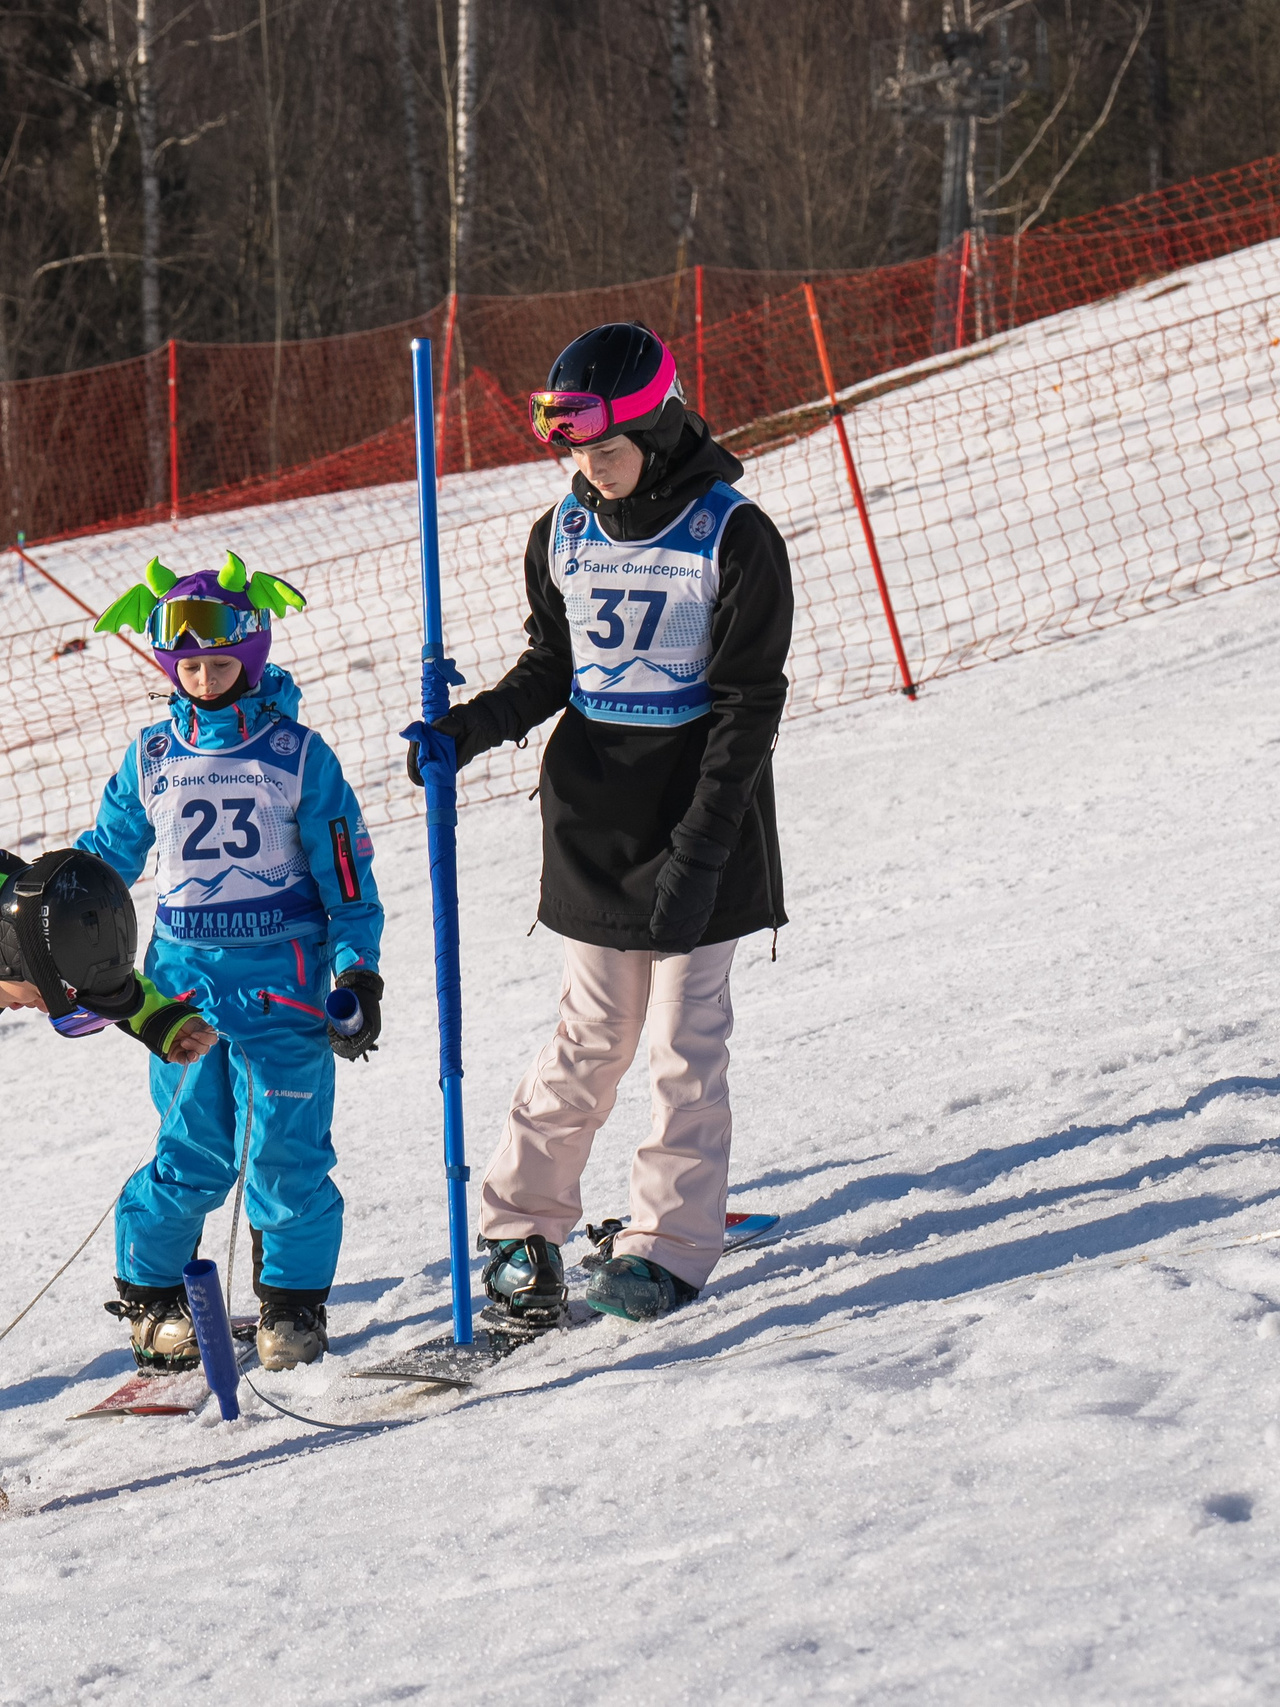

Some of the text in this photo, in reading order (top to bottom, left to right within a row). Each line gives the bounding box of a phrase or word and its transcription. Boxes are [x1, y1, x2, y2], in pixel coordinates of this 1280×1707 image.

[583, 560, 702, 579] Банк Финсервис
[586, 588, 668, 651] 37
[172, 775, 205, 788] Банк
[181, 798, 261, 861] 23
[171, 909, 284, 928] ШУКОЛОВО
[171, 926, 254, 939] МОСКОВСКАЯ
